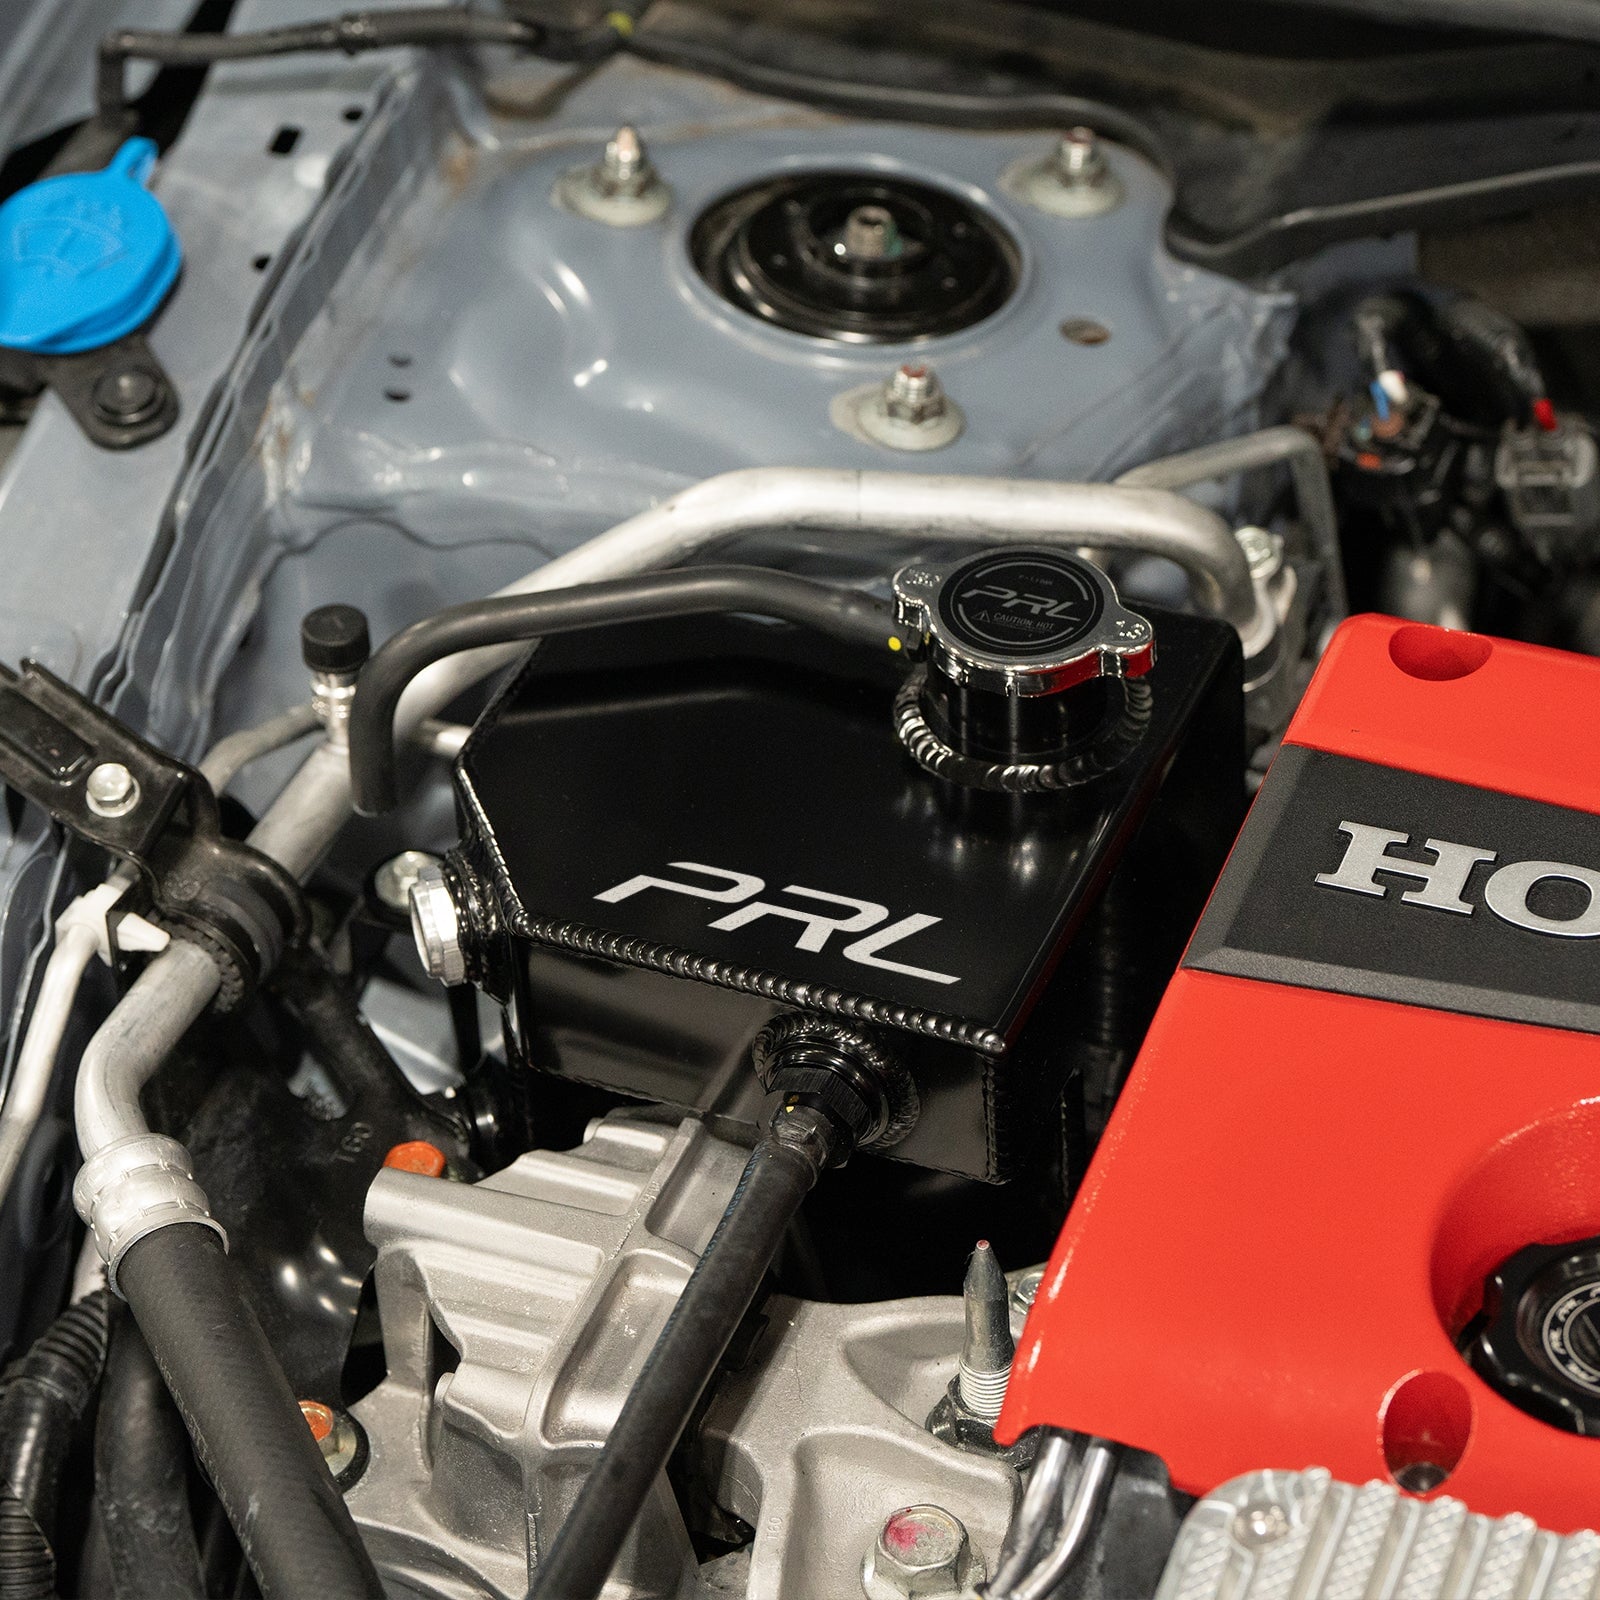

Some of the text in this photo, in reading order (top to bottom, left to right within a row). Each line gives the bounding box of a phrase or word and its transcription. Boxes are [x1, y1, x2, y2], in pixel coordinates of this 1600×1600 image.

[961, 585, 1081, 622] PRL
[593, 862, 961, 985] PRL
[1314, 820, 1600, 937] HO
